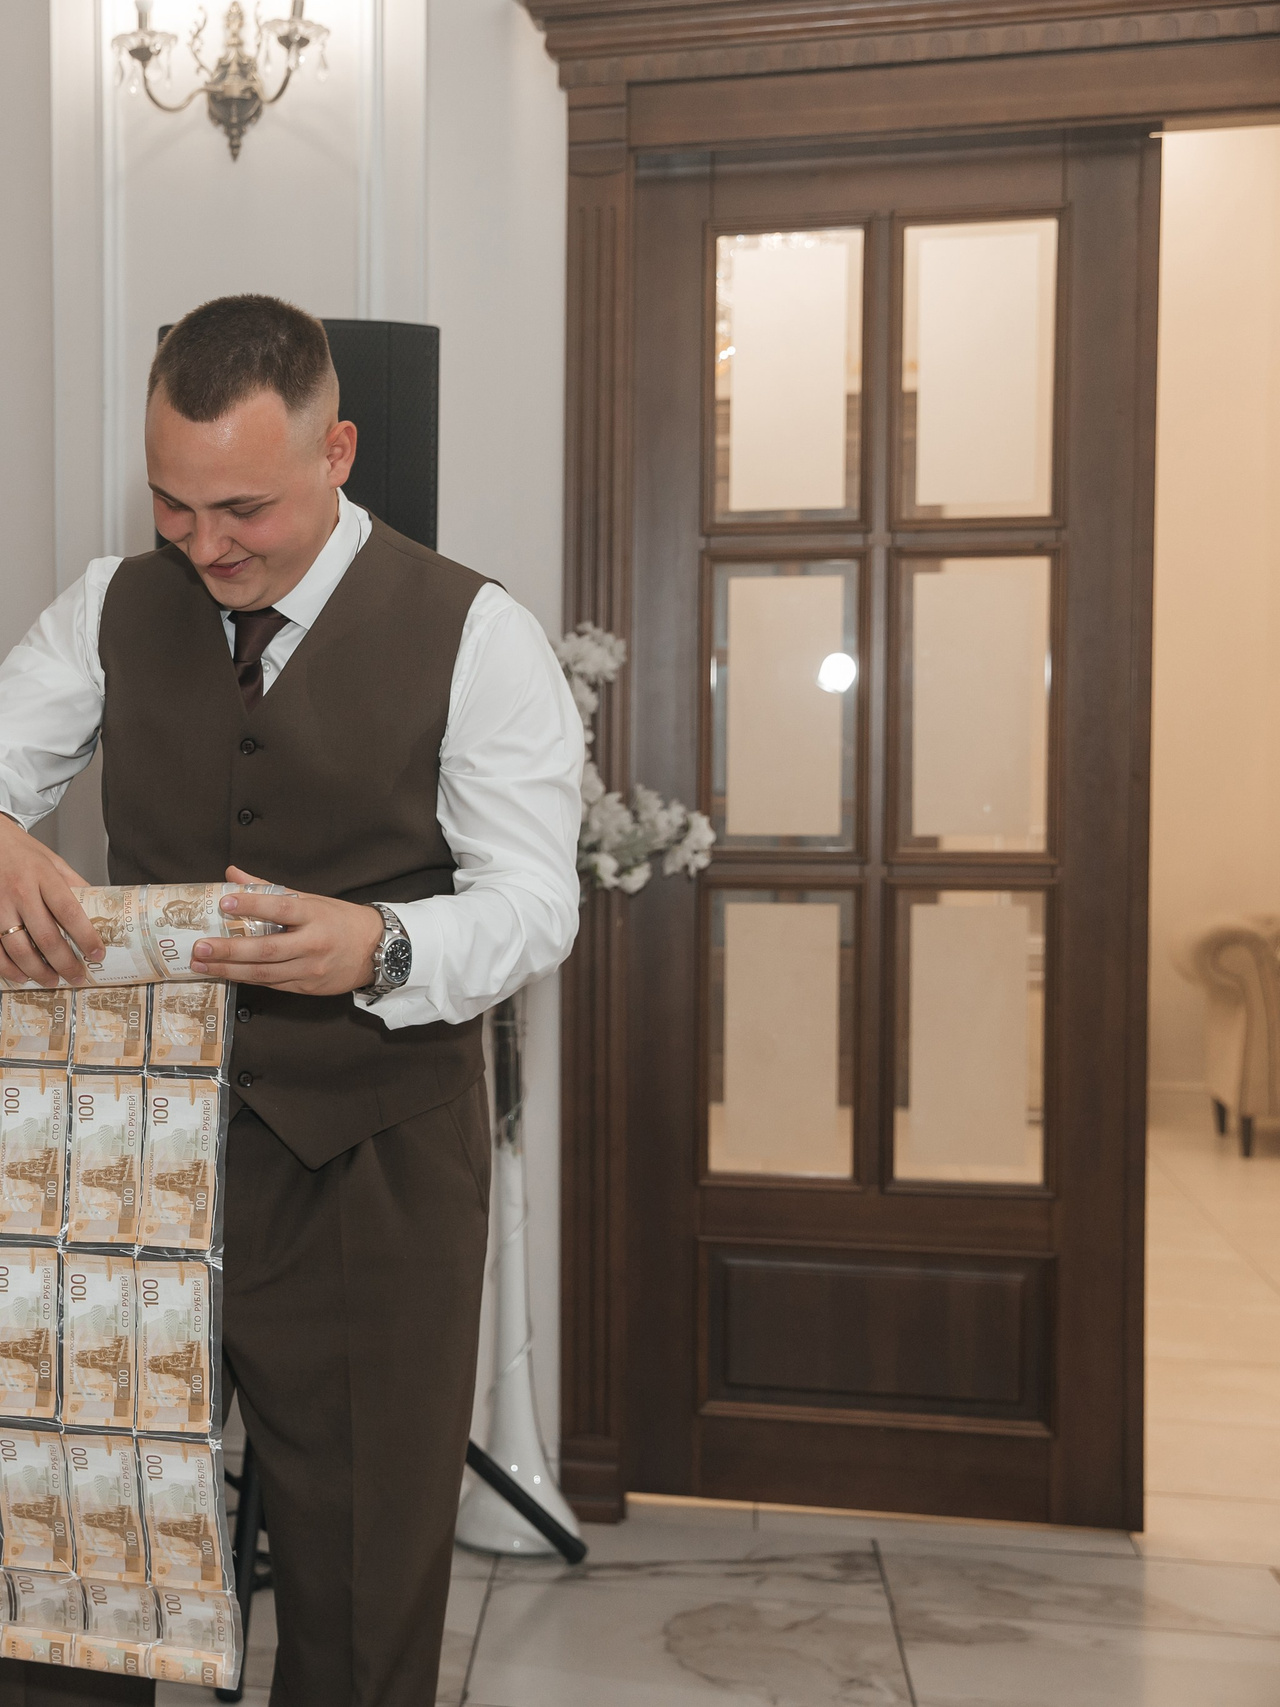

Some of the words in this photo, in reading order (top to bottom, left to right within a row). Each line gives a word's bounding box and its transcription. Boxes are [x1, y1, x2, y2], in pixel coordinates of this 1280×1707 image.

[159, 939, 179, 962] 100
[54, 1005, 65, 1023] 100
[129, 1011, 139, 1029] 100
[206, 1015, 216, 1033] 100
[5, 1088, 20, 1116] 100
[79, 1095, 94, 1123] 100
[153, 1098, 168, 1126] 100
[47, 1181, 57, 1199] 100
[124, 1188, 134, 1206] 100
[196, 1193, 206, 1211] 100
[71, 1274, 86, 1303] 100
[143, 1279, 158, 1308] 100
[40, 1361, 50, 1379] 100
[119, 1370, 129, 1388] 100
[192, 1375, 202, 1393] 100
[0, 1440, 17, 1462] 100
[71, 1448, 88, 1471] 100
[146, 1455, 163, 1481] 100
[55, 1522, 65, 1537] 100
[126, 1532, 136, 1546] 100
[202, 1541, 212, 1555] 100
[18, 1576, 35, 1595] 100
[90, 1585, 107, 1606] 100
[165, 1594, 182, 1616] 100
[204, 1668, 214, 1683] 100
